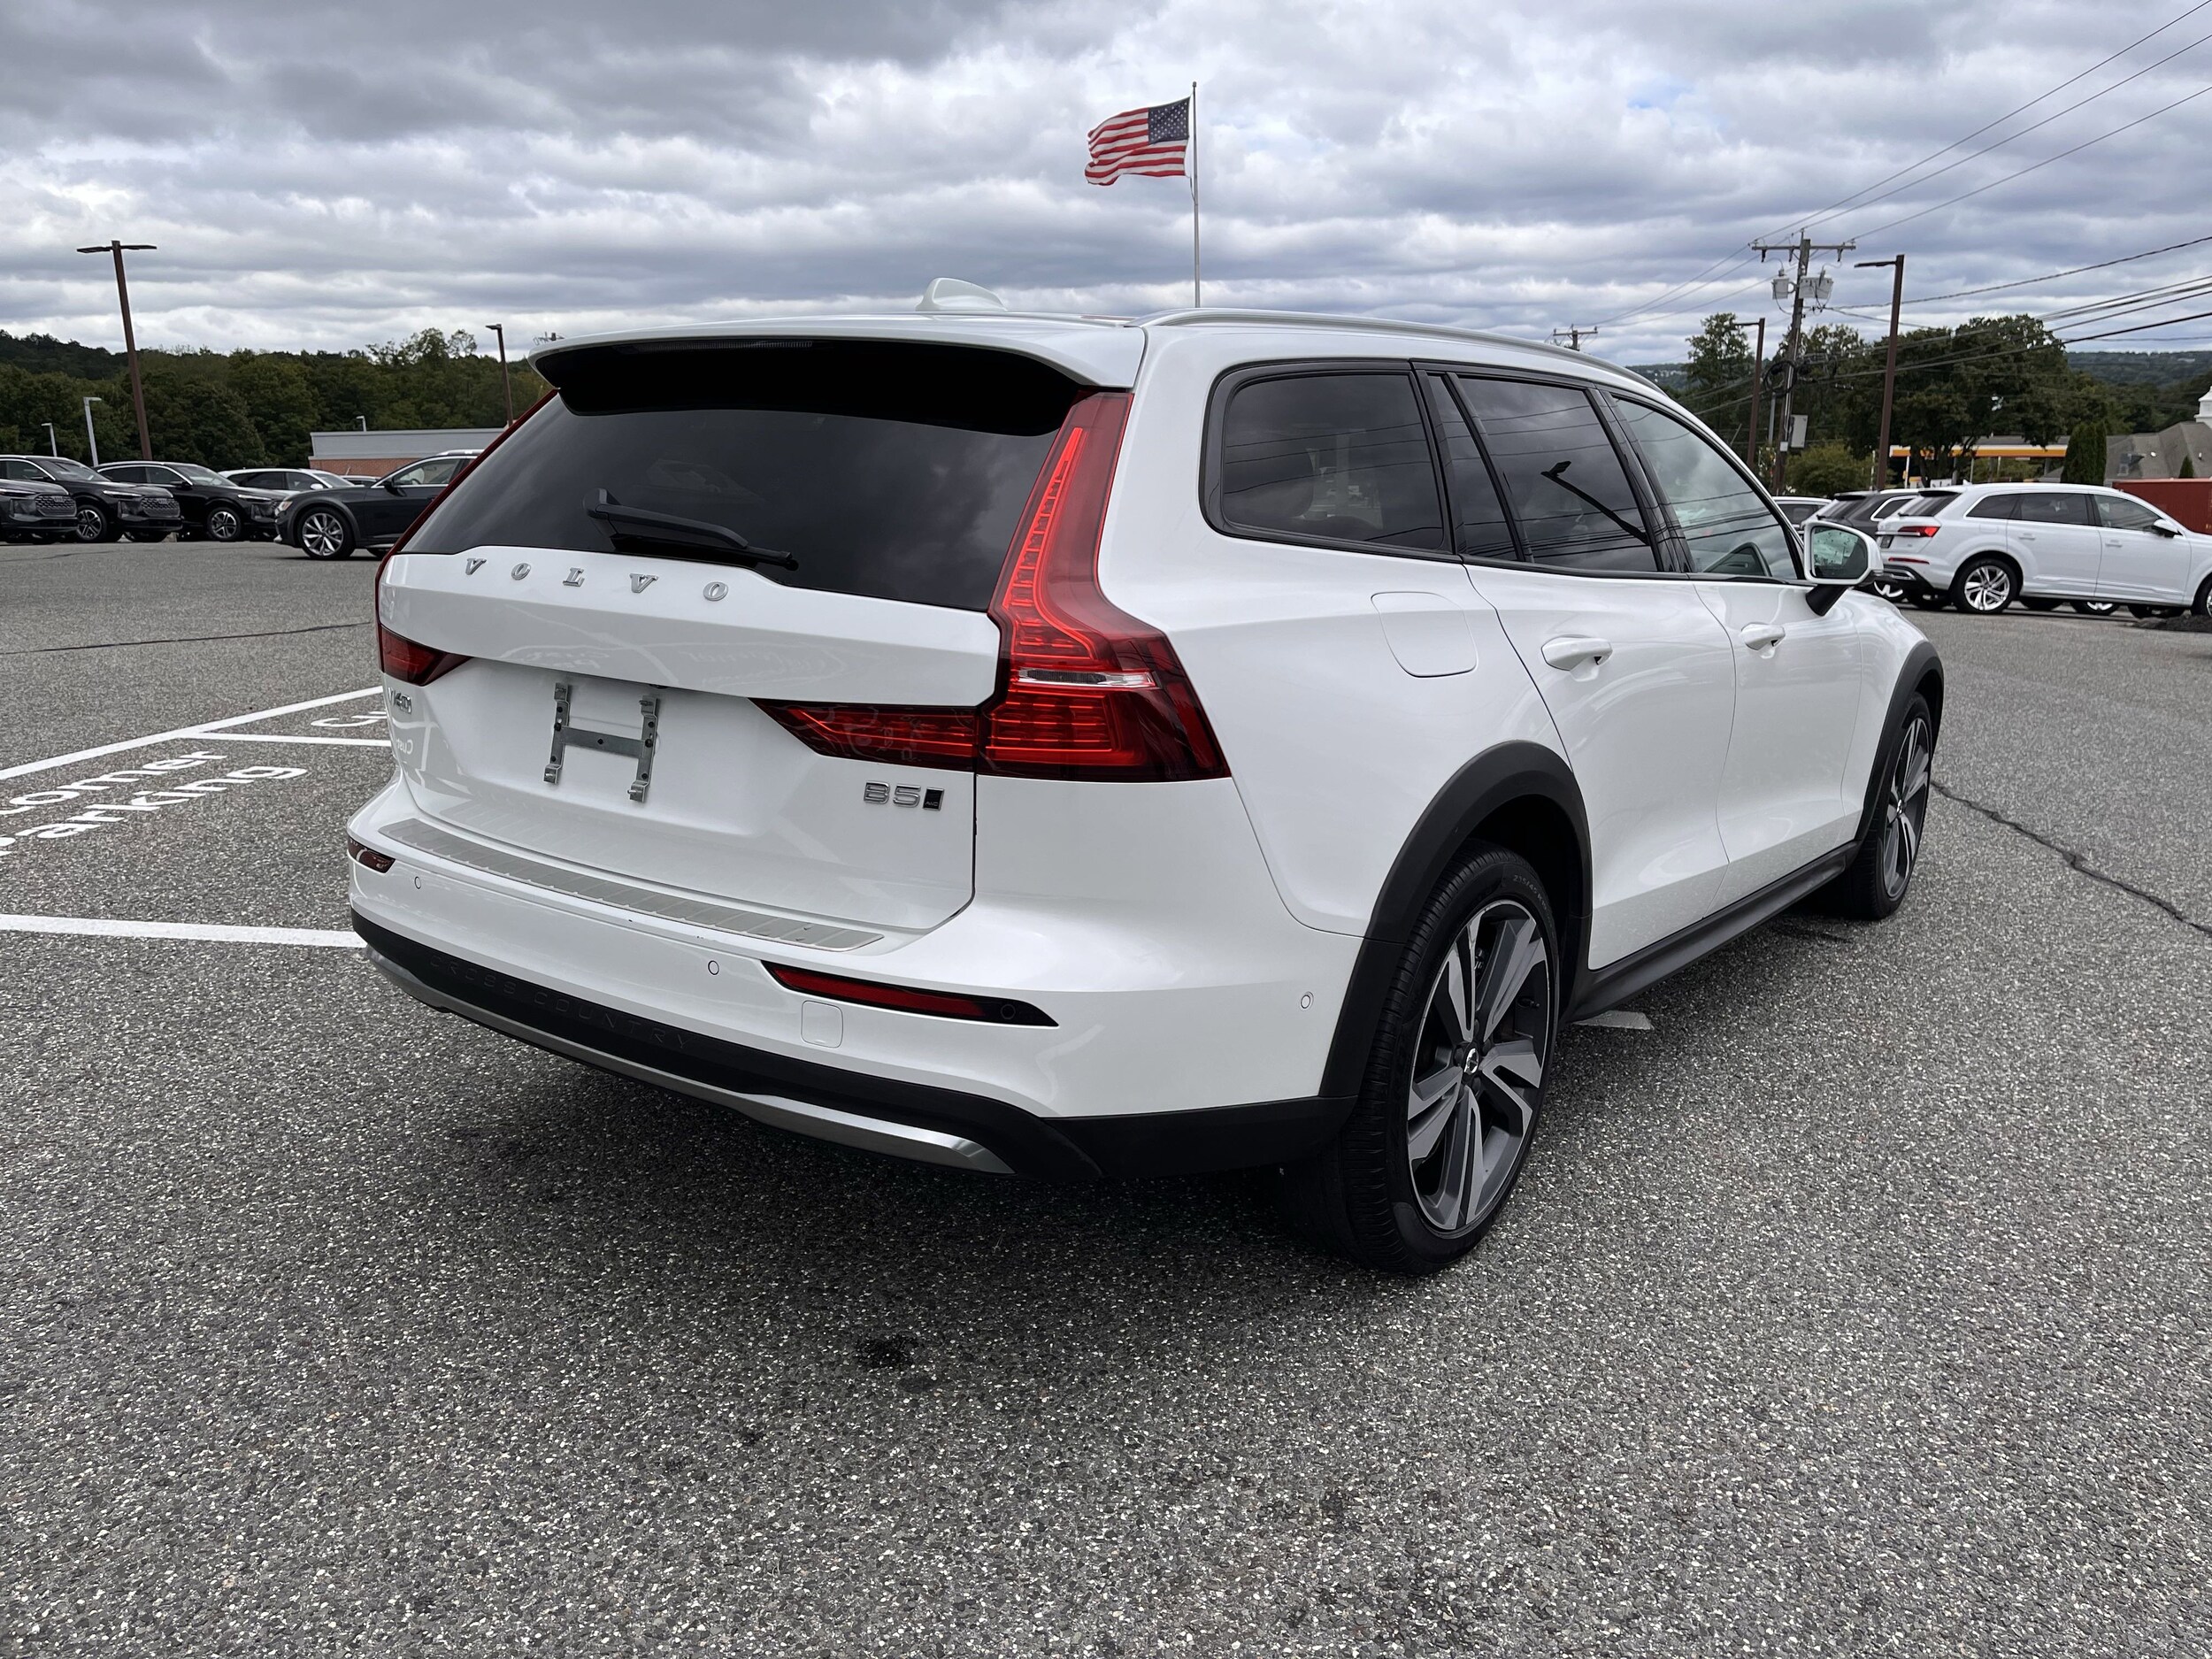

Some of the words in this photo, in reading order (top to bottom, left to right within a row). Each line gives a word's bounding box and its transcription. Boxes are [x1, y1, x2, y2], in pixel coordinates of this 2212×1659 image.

[466, 557, 729, 602] VOLVO
[864, 780, 921, 808] B5
[429, 955, 518, 995] CROSS
[534, 990, 688, 1049] COUNTRY
